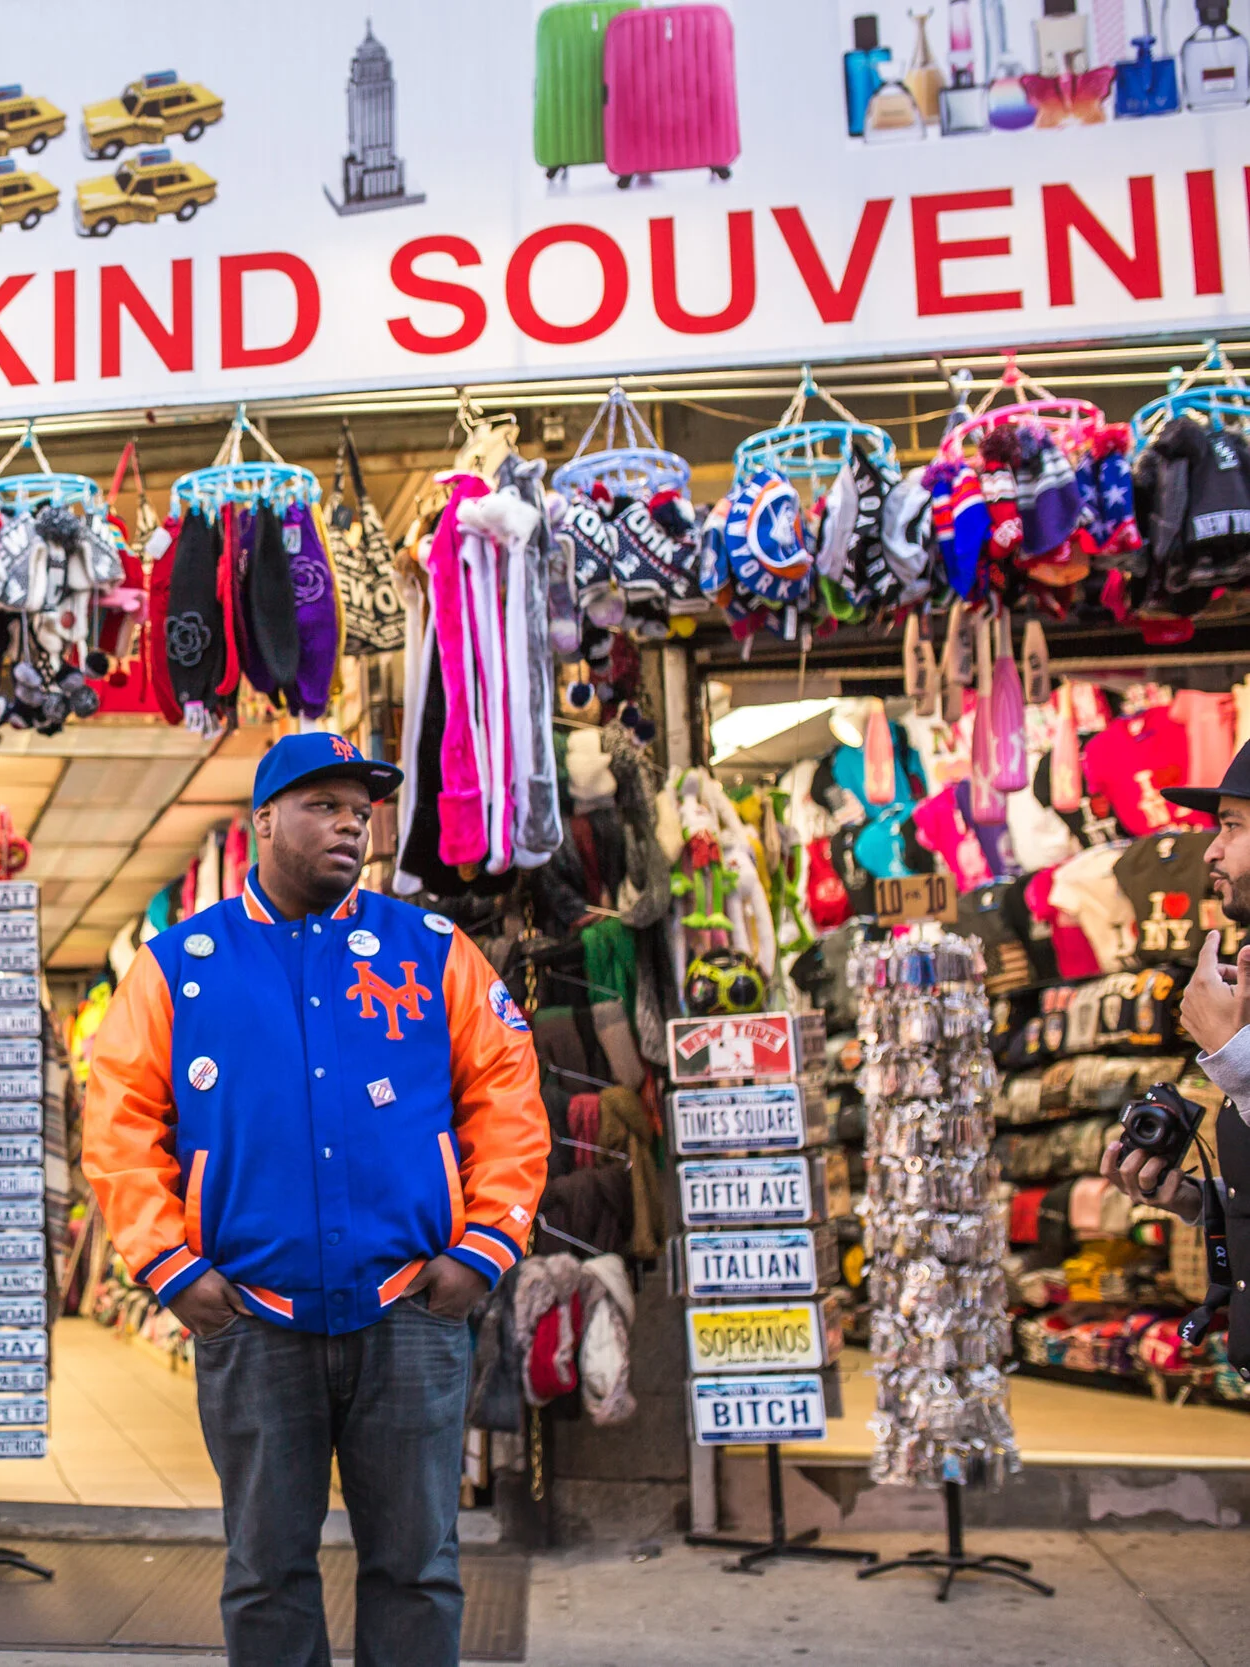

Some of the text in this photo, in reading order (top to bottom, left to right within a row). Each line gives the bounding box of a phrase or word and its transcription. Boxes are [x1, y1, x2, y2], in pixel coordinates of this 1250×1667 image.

[386, 165, 1250, 355] SOUVENI
[878, 880, 903, 915] 10
[925, 877, 947, 914] 10
[1148, 891, 1166, 920] I
[1140, 919, 1193, 951] NY
[680, 1022, 782, 1057] NEW YORK
[681, 1107, 797, 1137] TIMES SQUARE
[691, 1180, 802, 1209] FIFTH AVE
[703, 1253, 801, 1280] ITALIAN
[699, 1322, 811, 1358] SOPRANOS
[713, 1398, 811, 1427] BITCH
